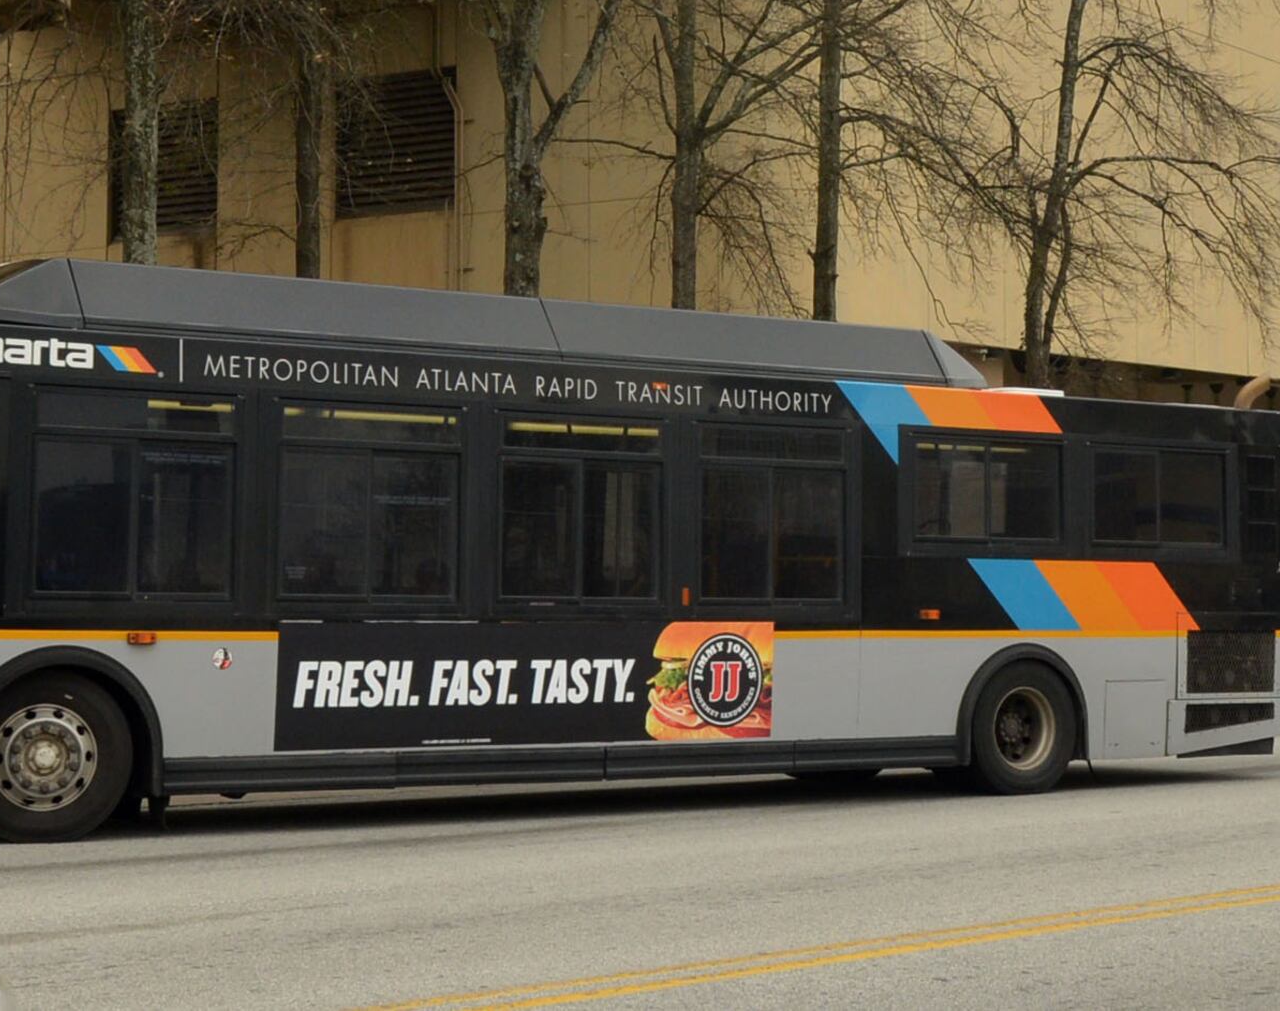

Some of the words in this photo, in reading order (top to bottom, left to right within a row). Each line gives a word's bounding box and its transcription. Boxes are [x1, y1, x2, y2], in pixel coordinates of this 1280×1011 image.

[203, 354, 399, 388] METROPOLITAN
[416, 368, 517, 395] ATLANTA
[535, 376, 598, 400] RAPID
[615, 381, 703, 406] TRANSIT
[719, 389, 832, 413] AUTHORITY
[293, 661, 419, 708] FRESH.
[428, 659, 518, 706] FAST.
[530, 658, 635, 704] TASTY.
[694, 642, 724, 681] JIMMY
[727, 641, 757, 681] JOHN'S
[709, 661, 742, 702] JJ
